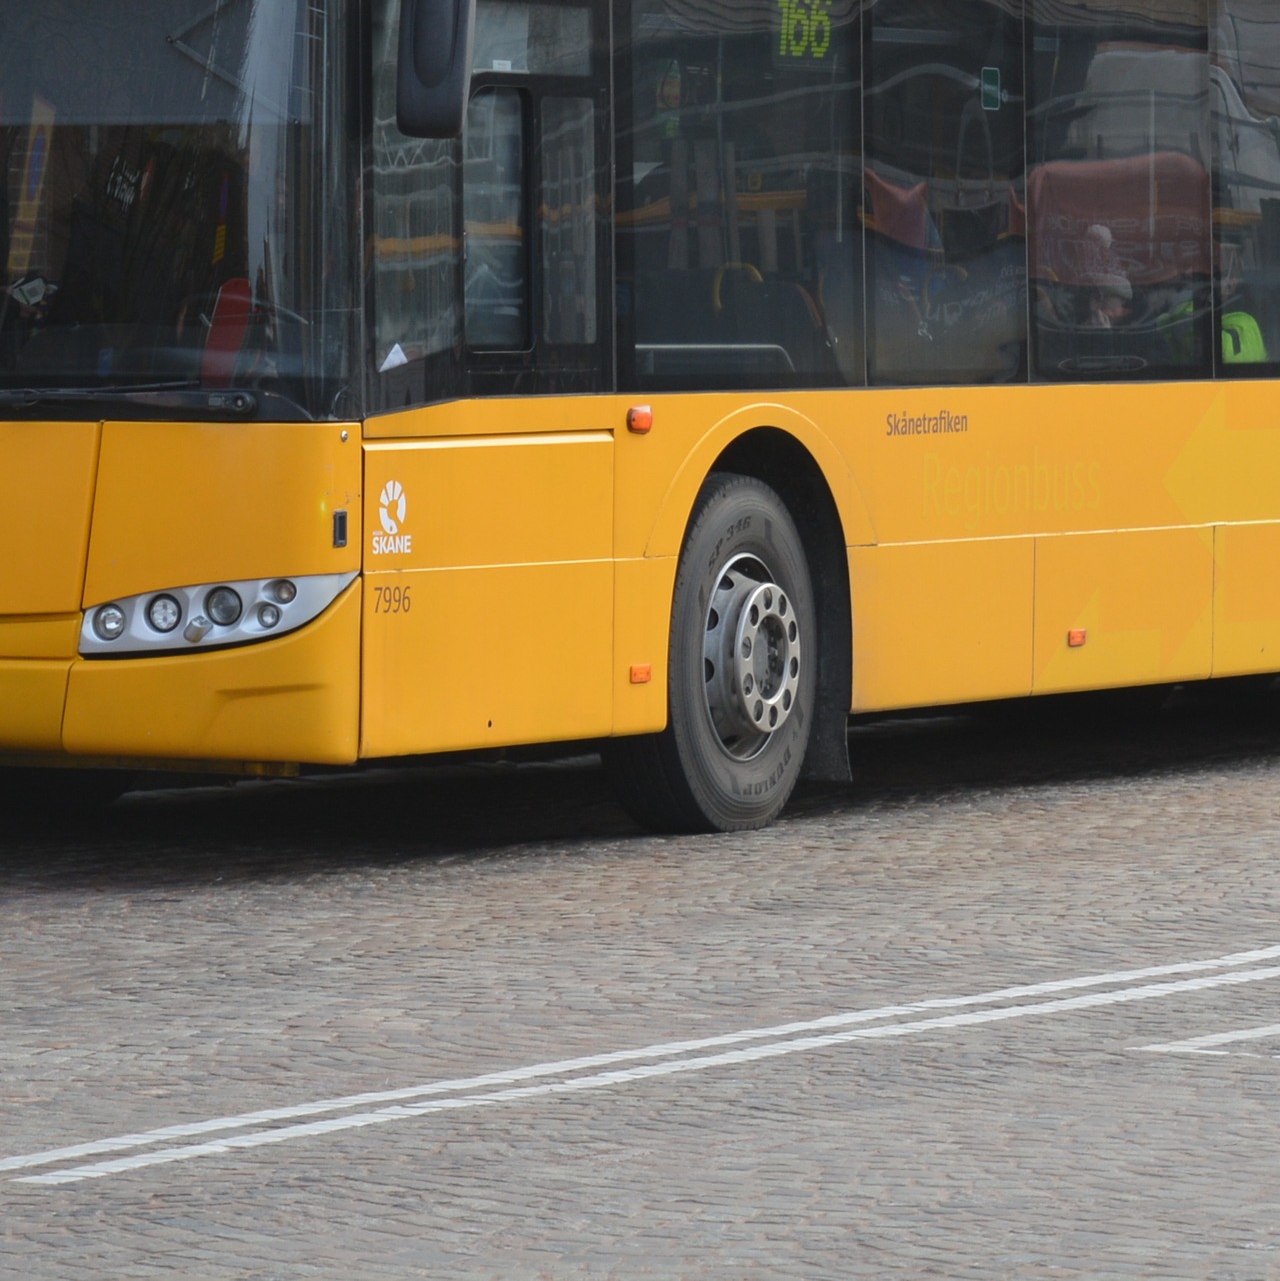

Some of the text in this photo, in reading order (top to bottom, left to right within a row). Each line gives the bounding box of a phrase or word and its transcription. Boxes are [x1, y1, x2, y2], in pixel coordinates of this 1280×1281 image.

[886, 410, 968, 436] Skånetrafiken
[922, 444, 1102, 531] Regionbuss
[373, 586, 412, 613] 7996
